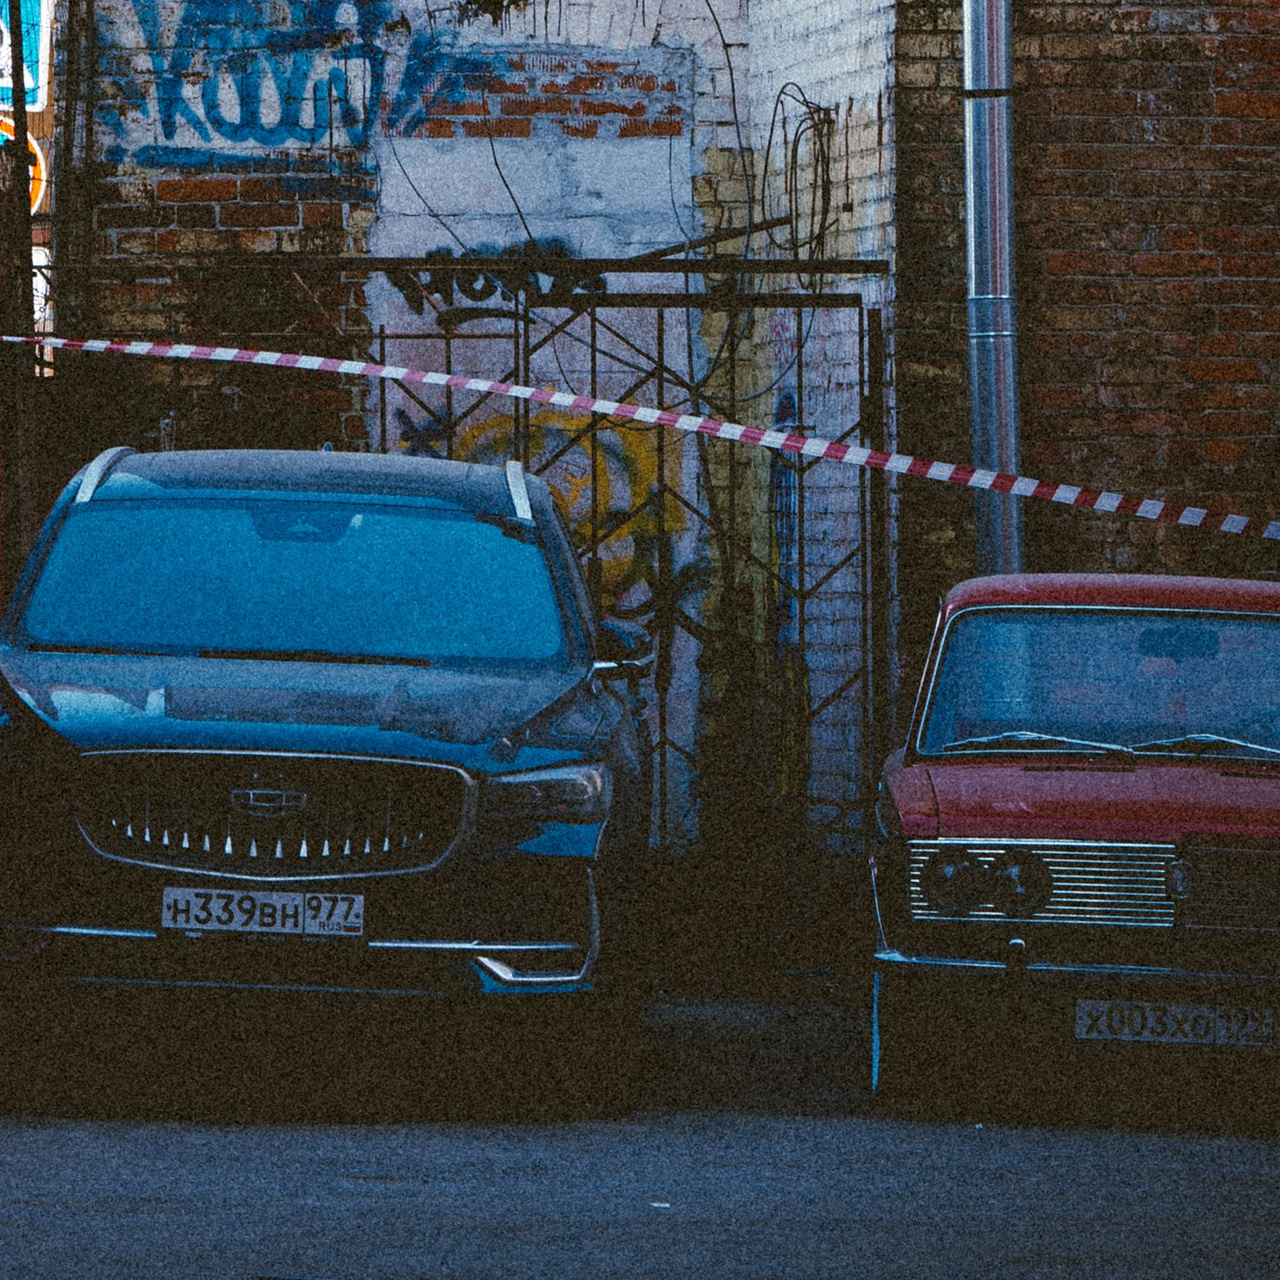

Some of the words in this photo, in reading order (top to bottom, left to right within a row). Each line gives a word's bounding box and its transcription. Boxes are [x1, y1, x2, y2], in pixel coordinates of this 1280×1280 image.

[172, 893, 299, 928] Н339ВН
[306, 895, 356, 921] 977
[319, 921, 342, 931] RUS
